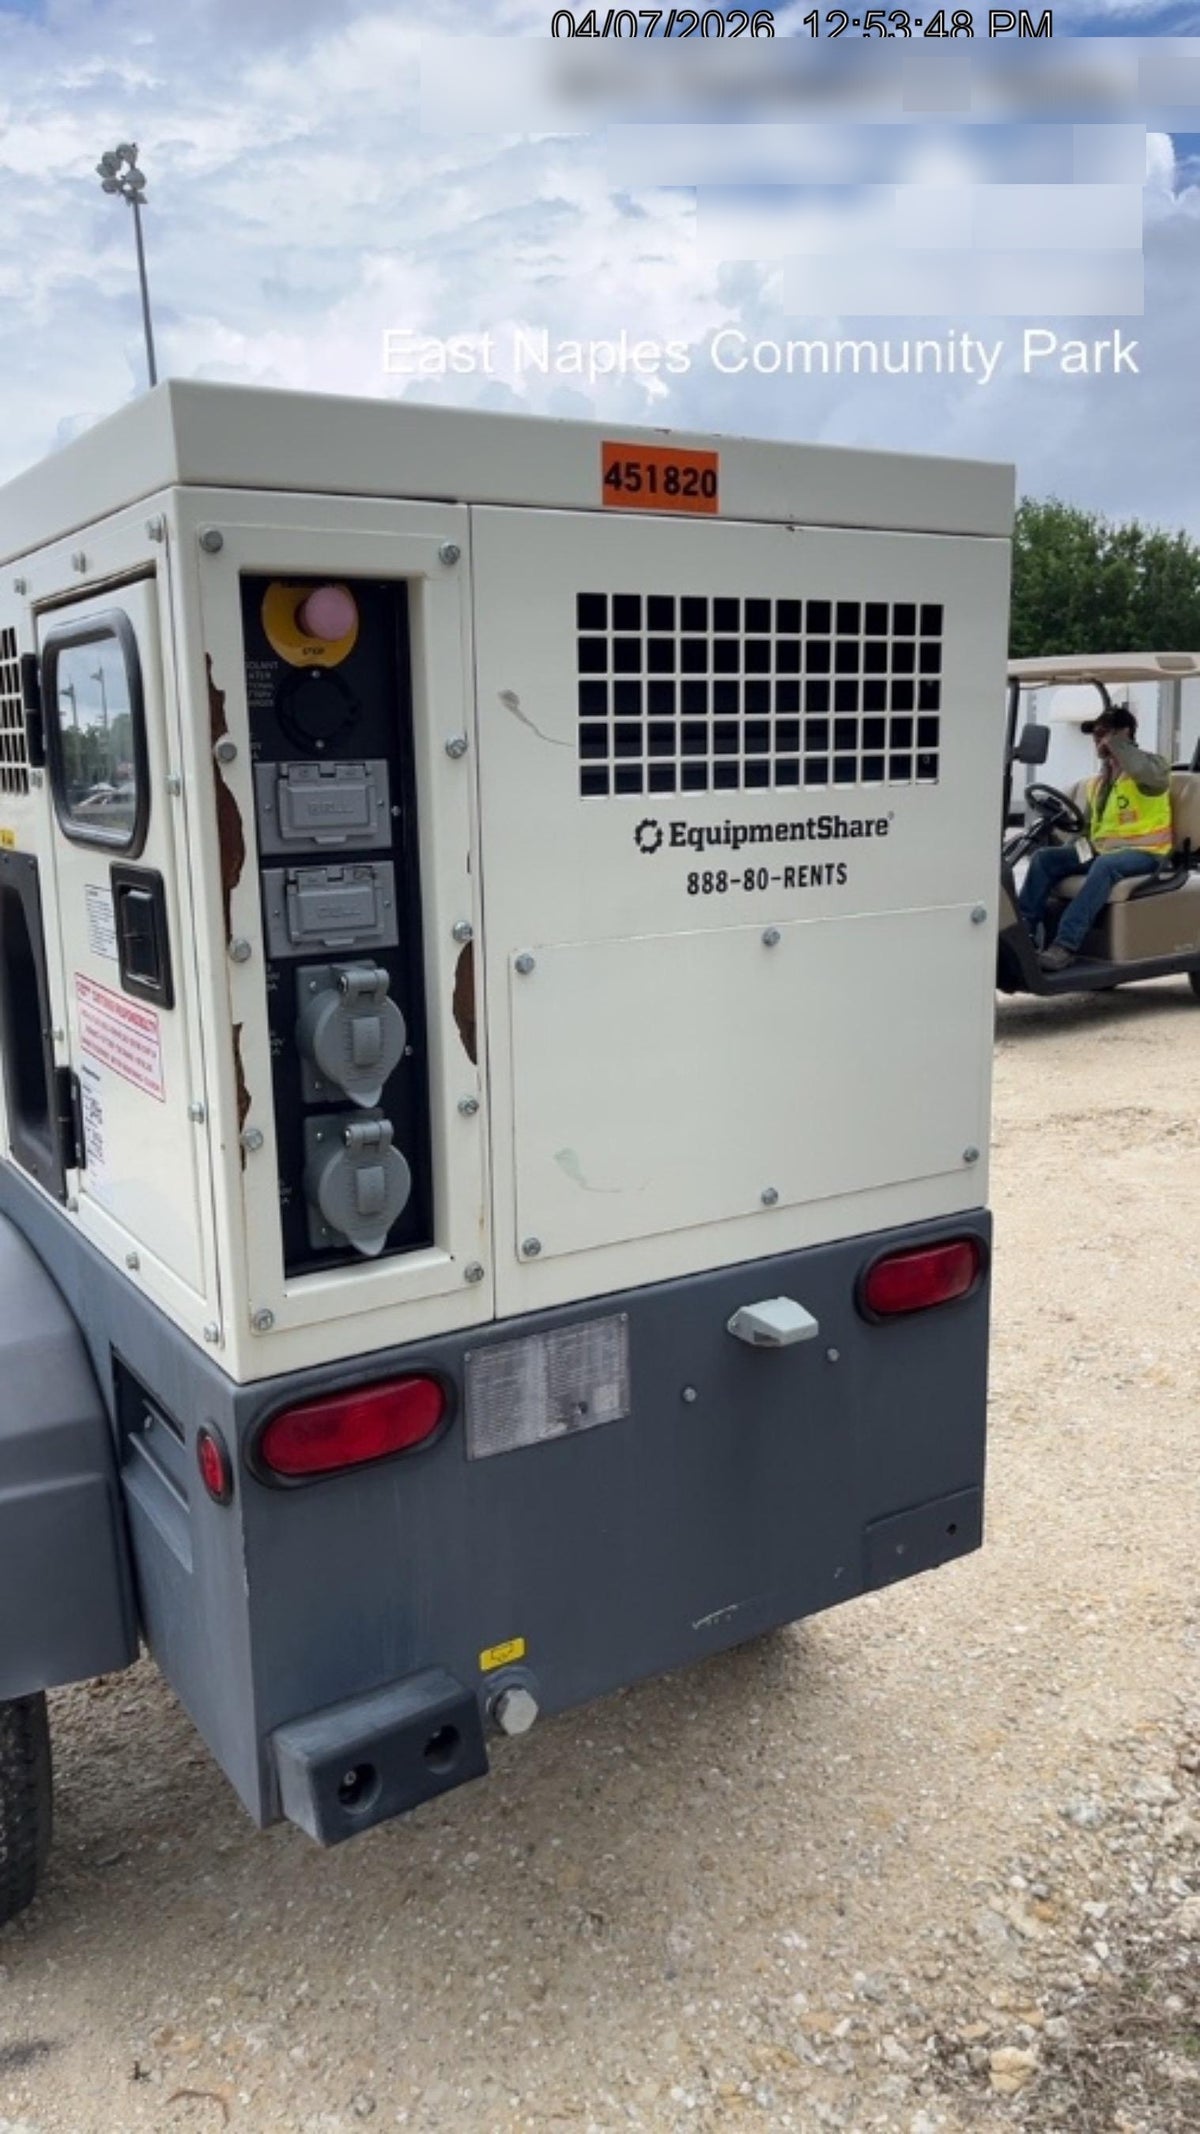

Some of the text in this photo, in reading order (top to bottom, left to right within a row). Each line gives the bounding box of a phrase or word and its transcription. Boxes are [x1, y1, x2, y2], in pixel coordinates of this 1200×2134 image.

[604, 461, 718, 498] 451820
[668, 814, 889, 852] EquipmentShare
[686, 862, 848, 895] 888-80-RENTS
